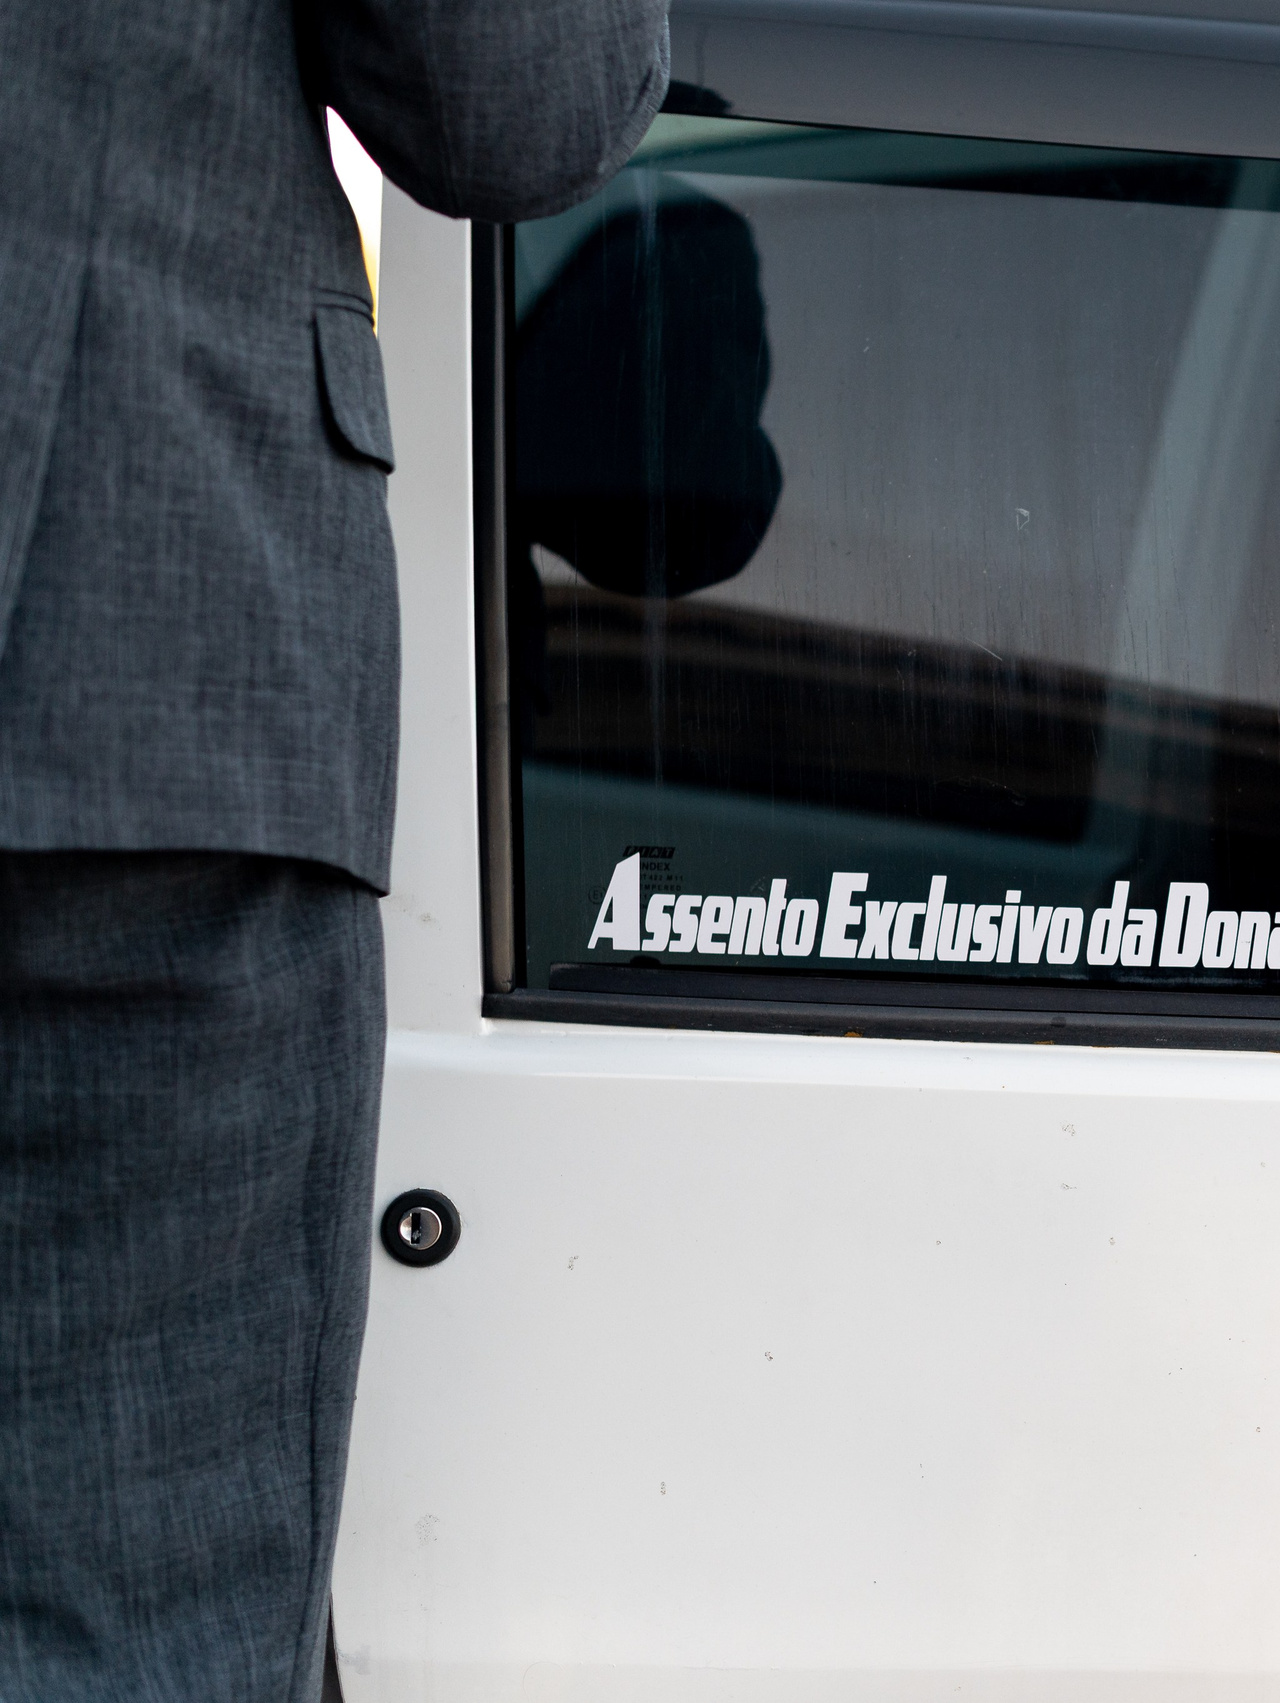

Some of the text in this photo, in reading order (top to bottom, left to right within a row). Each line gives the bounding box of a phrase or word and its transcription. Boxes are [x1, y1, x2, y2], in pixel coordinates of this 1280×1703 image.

[641, 862, 671, 871] NDEX
[641, 884, 682, 892] MPERED
[588, 853, 819, 956] Assento
[820, 872, 1083, 964] Exclusivo
[1087, 881, 1157, 966] da
